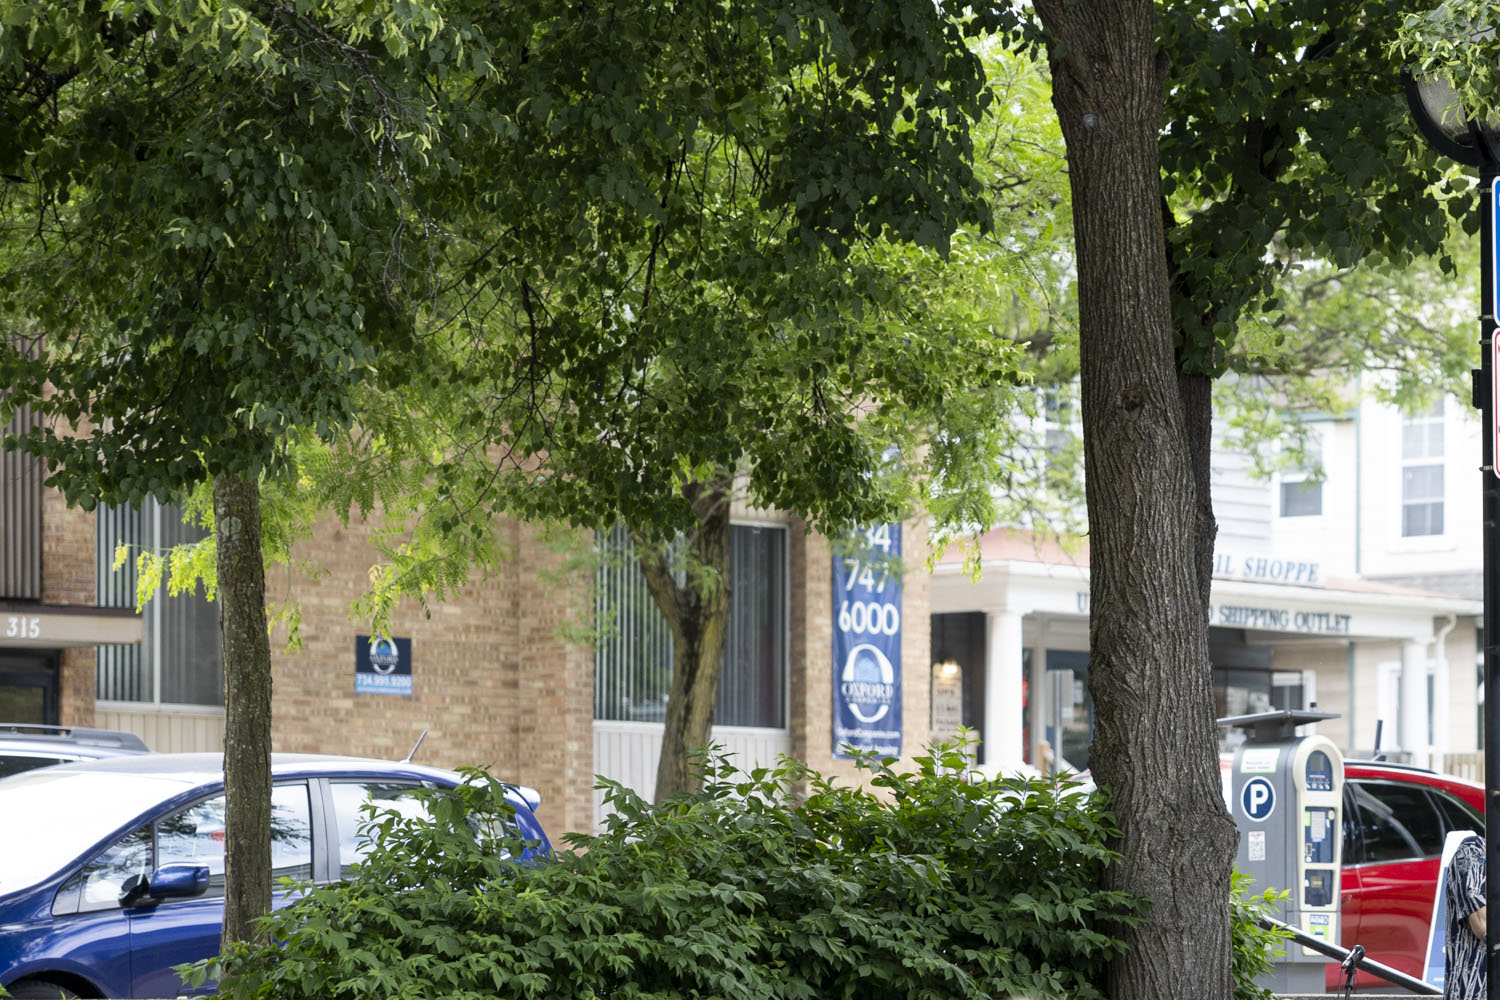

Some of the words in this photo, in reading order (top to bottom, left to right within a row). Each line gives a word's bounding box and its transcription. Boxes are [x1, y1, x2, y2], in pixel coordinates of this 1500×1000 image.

[1243, 557, 1319, 583] SHOPPE
[6, 616, 40, 639] 315
[838, 600, 900, 636] 6000
[1219, 605, 1290, 629] SHIPPING
[1294, 611, 1353, 633] OUTLET
[841, 681, 894, 699] OXFORD
[1250, 784, 1269, 815] P
